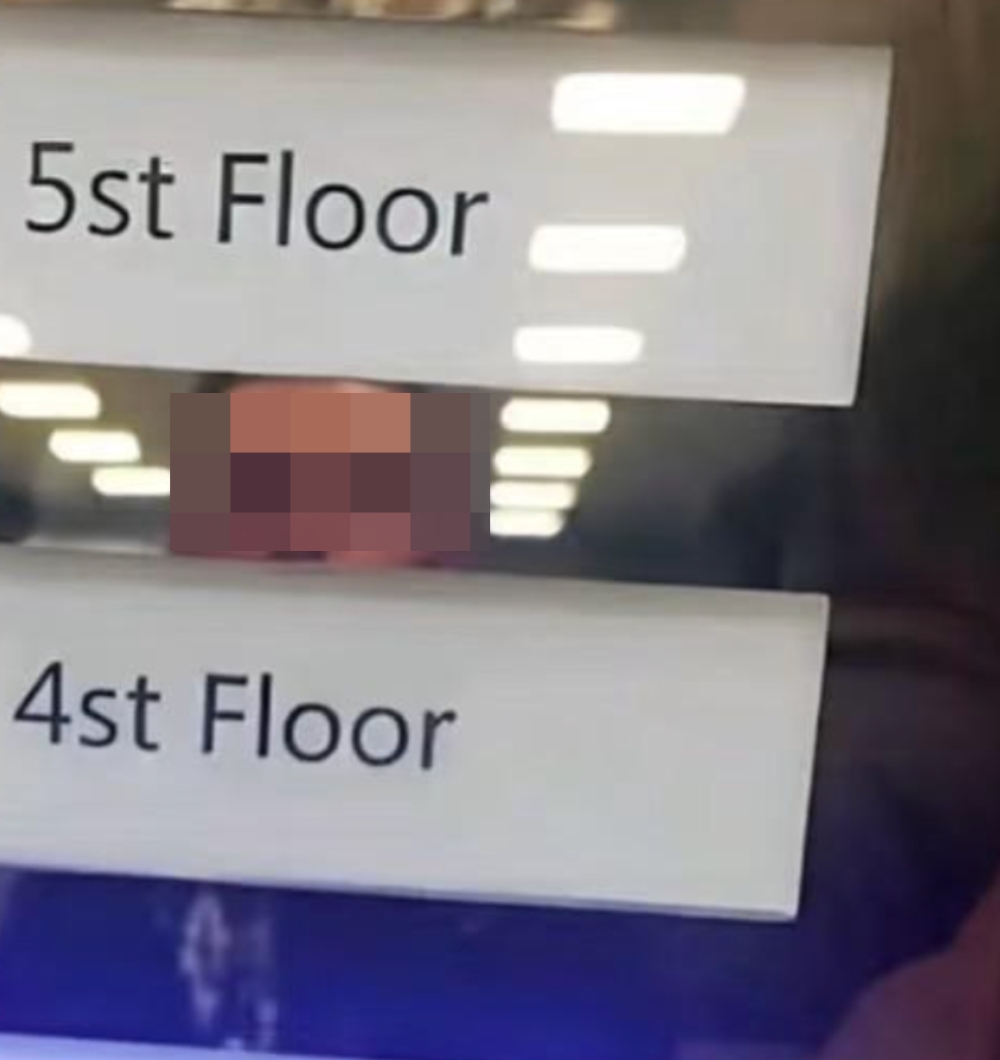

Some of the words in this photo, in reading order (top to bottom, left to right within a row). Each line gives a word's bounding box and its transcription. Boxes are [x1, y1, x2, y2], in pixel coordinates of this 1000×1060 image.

[25, 141, 176, 240] 5st
[217, 149, 490, 256] Floor
[12, 660, 161, 752] 4st
[201, 672, 457, 770] Floor
